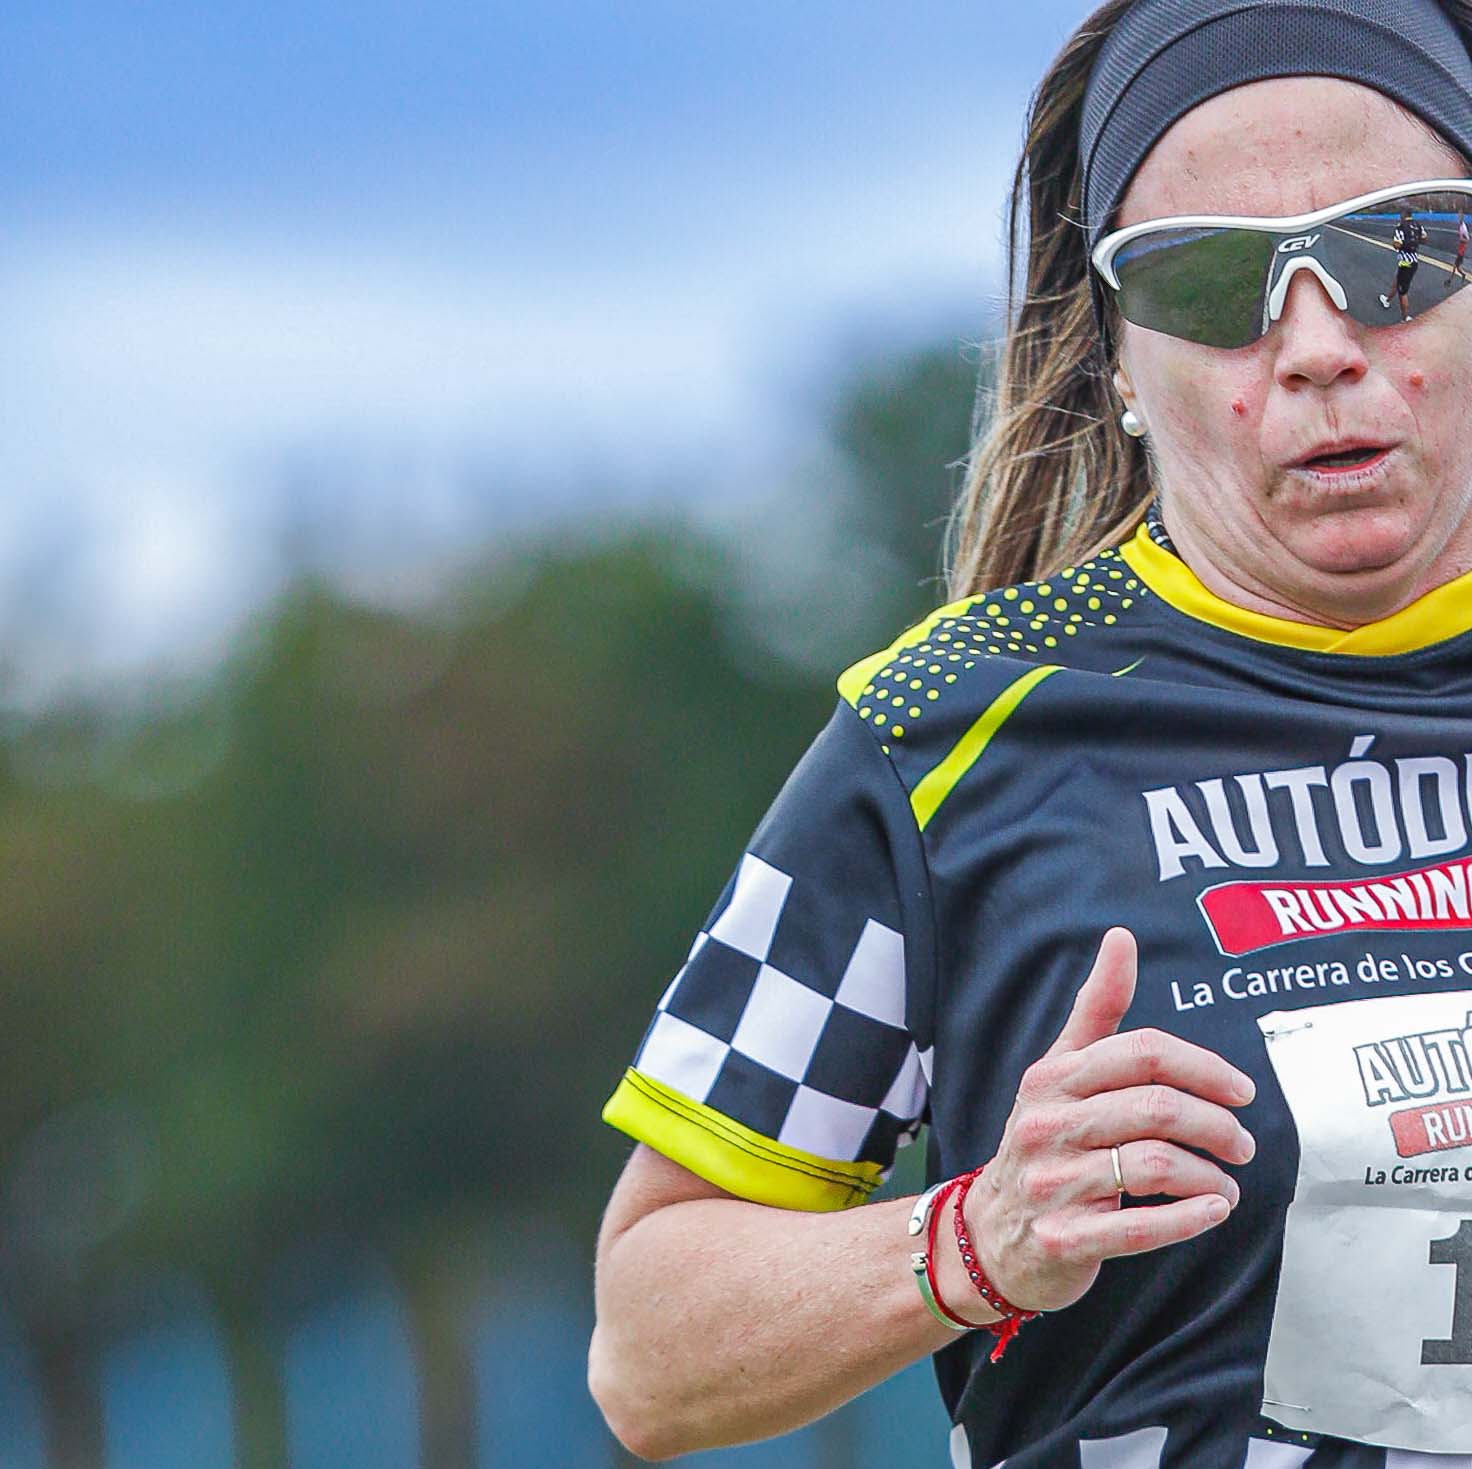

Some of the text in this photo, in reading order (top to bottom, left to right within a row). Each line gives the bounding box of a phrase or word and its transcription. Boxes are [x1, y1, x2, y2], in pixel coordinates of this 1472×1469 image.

[1170, 981, 1214, 1012] La
[1222, 961, 1350, 1000] Carrera
[1356, 953, 1399, 983] de
[1401, 953, 1454, 980] los
[1364, 1166, 1386, 1186] La
[1391, 1165, 1459, 1185] Carrera
